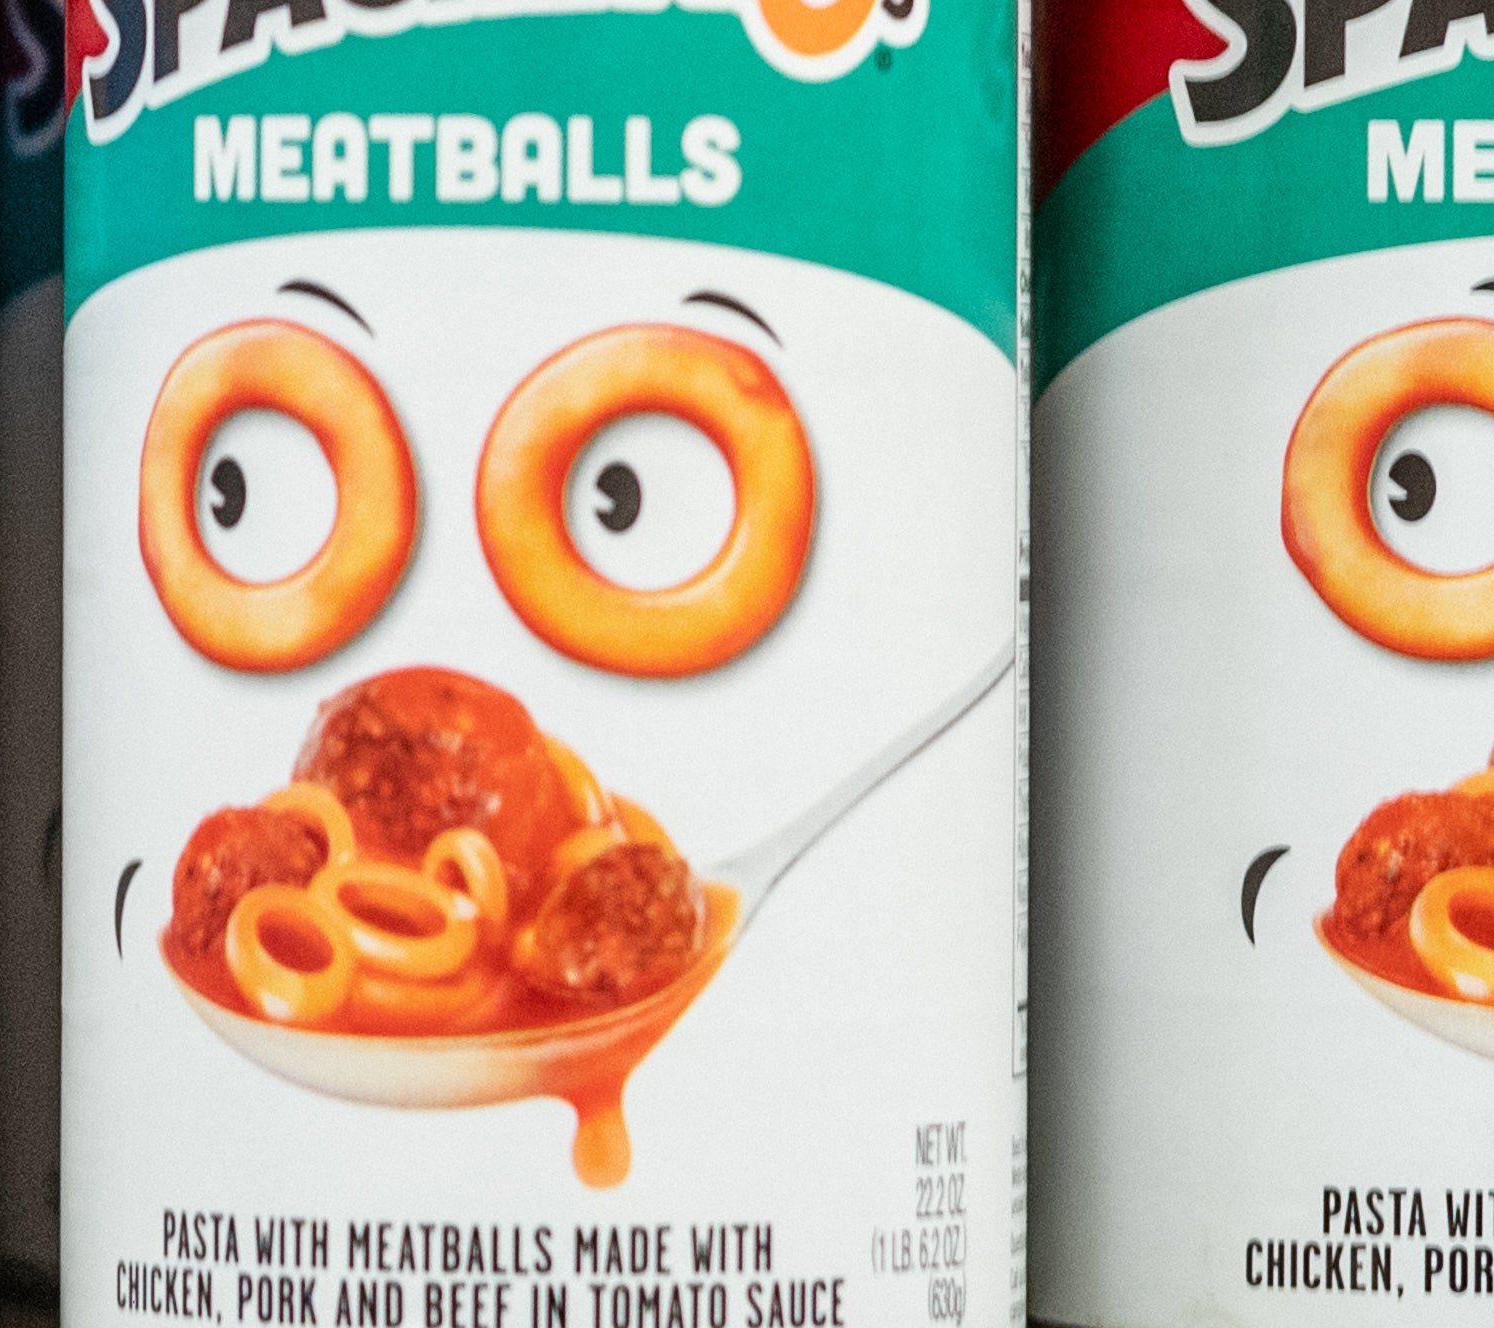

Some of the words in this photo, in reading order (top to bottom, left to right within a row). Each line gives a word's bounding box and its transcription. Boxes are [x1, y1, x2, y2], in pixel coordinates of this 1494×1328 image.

[194, 113, 741, 206] MEATBALLS
[163, 1209, 239, 1264] PASTA
[255, 1217, 328, 1269] WITH
[348, 1222, 552, 1275] MEATBALLS
[575, 1226, 670, 1275] MADE
[691, 1224, 772, 1273] WITH
[1323, 1187, 1426, 1237] PASTA
[117, 1261, 221, 1324] CHICKEN,
[238, 1273, 317, 1326] PORK
[336, 1280, 403, 1328] AND
[1246, 1239, 1403, 1298] CHICKEN,
